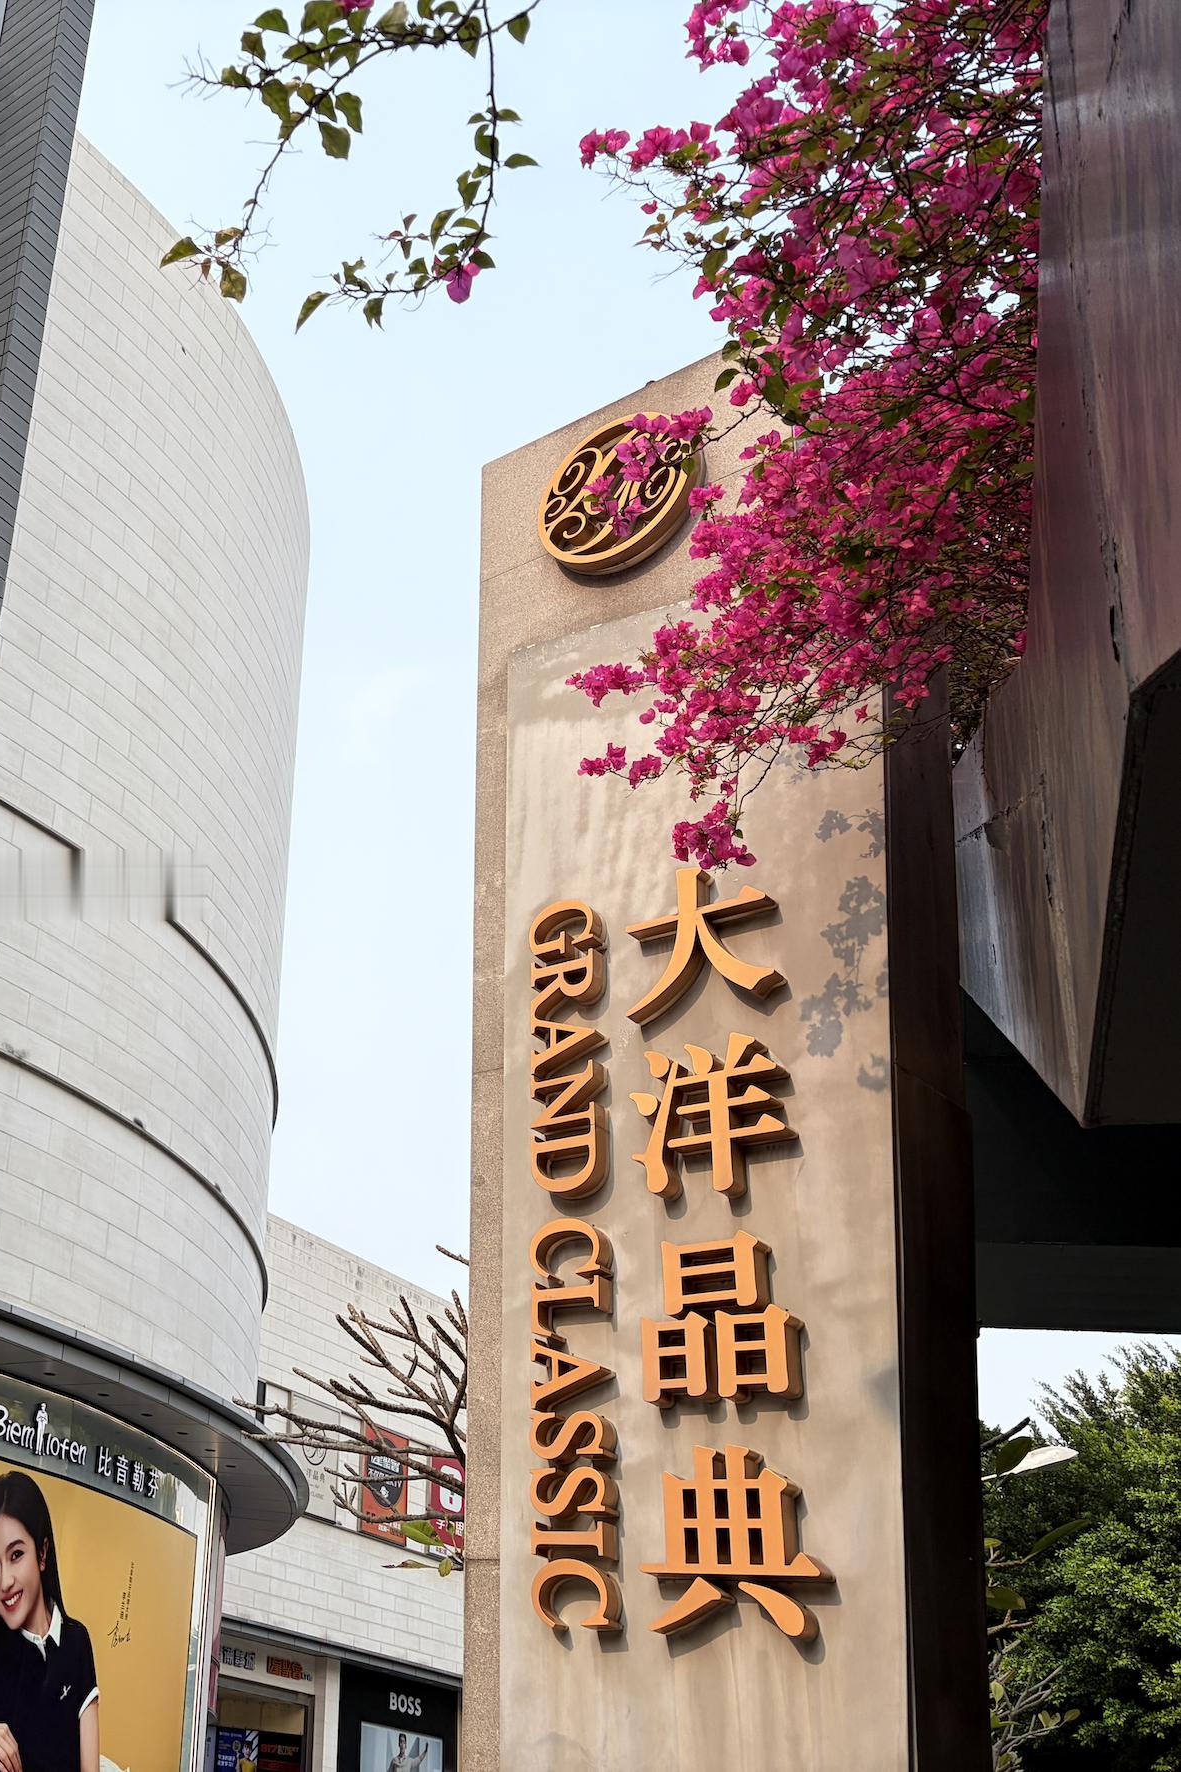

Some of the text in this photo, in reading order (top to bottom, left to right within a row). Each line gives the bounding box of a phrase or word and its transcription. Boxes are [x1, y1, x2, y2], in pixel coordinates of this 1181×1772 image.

[528, 899, 622, 1632] GRAND CLASSIC
[626, 867, 839, 1644] 大洋晶典
[98, 1446, 161, 1499] 比音勒芬
[389, 1691, 422, 1717] BOSS
